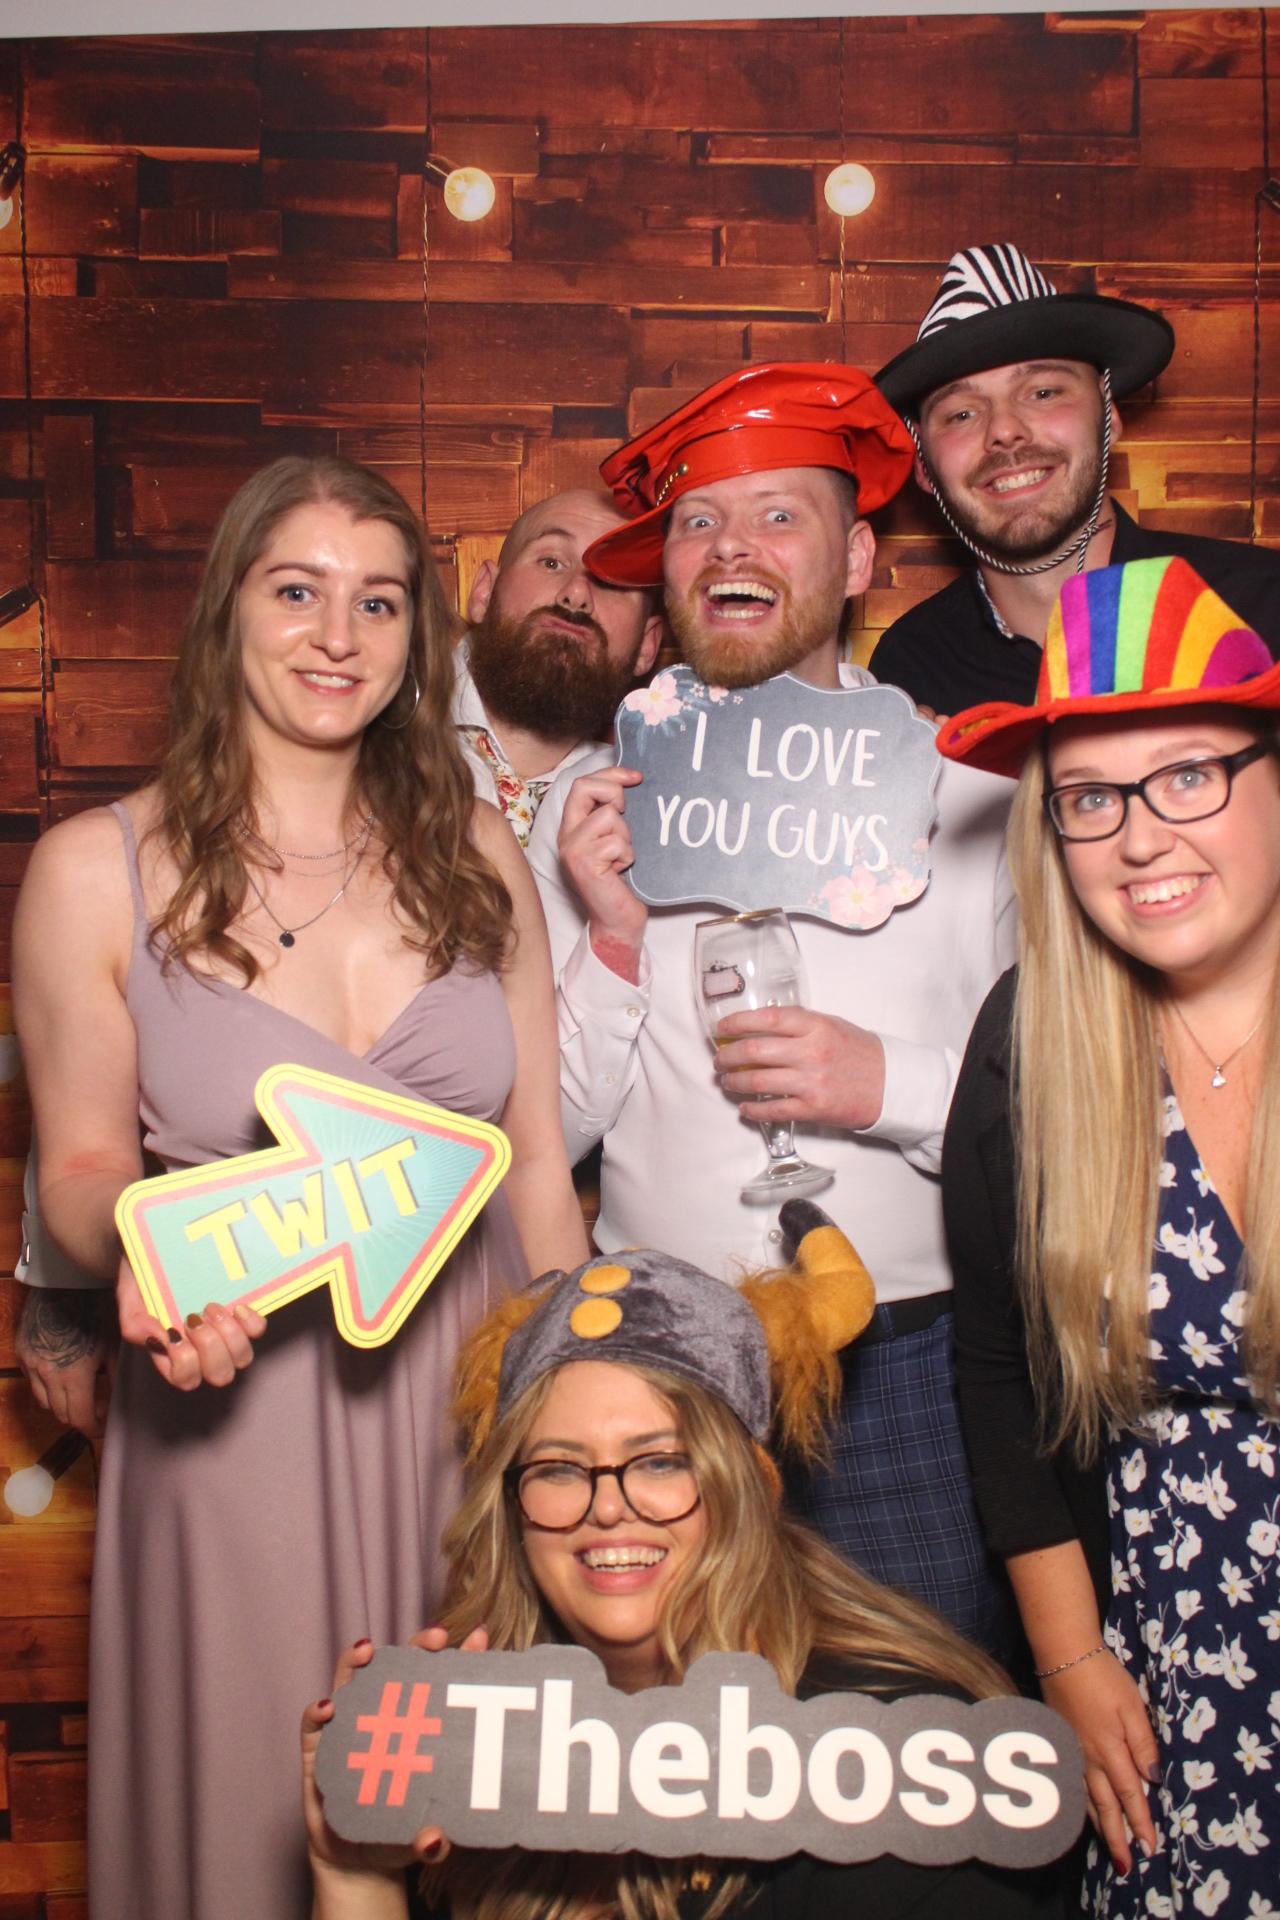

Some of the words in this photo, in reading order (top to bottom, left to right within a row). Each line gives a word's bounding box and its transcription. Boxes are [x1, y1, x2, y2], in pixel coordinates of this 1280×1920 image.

[692, 711, 707, 771] I
[747, 718, 881, 787] LOVE
[657, 795, 751, 856] YOU
[767, 804, 888, 872] GUYS
[184, 1137, 419, 1281] TWIT
[347, 1680, 1061, 1829] #Theboss
